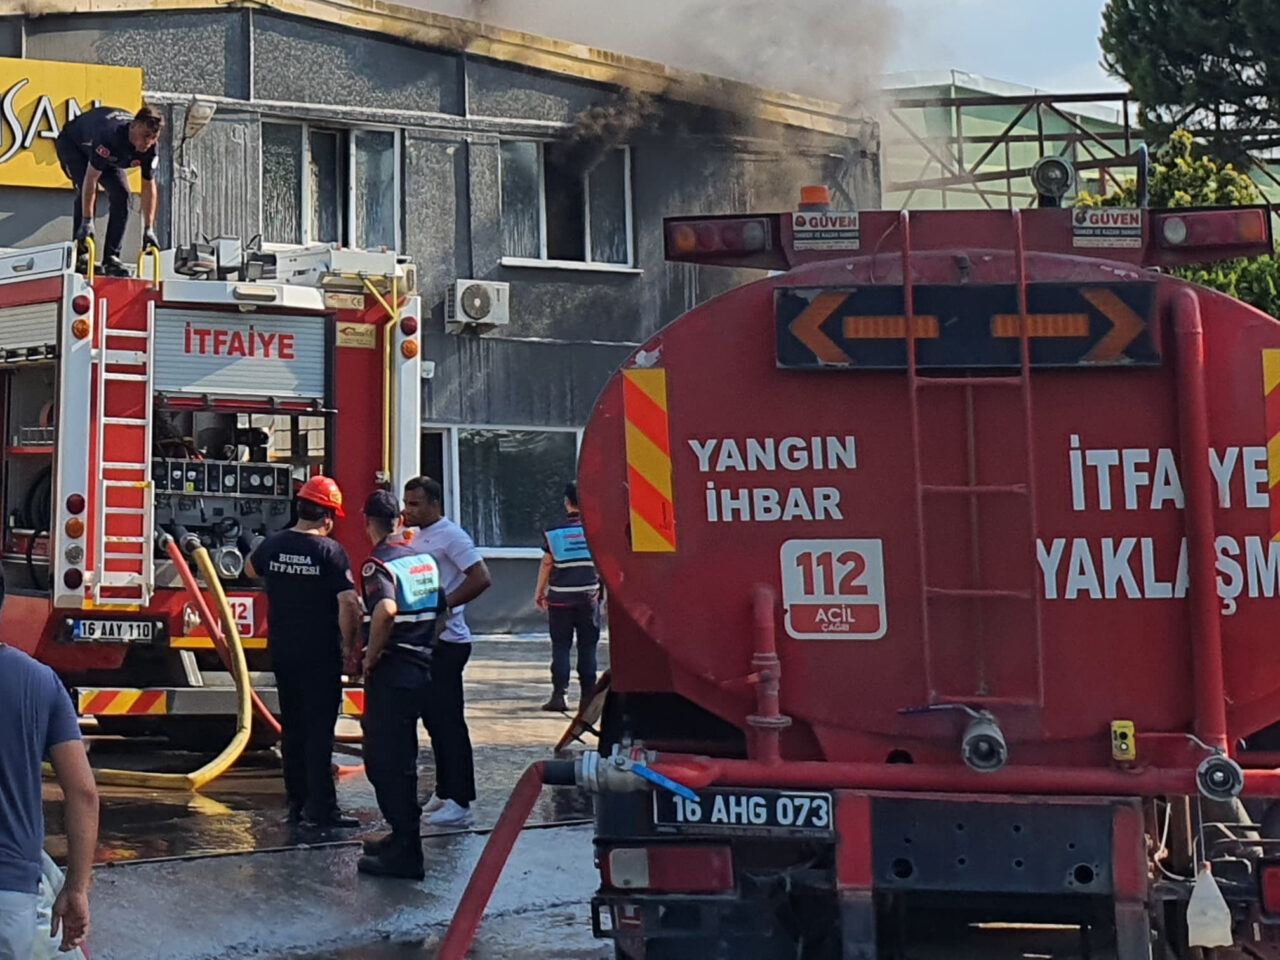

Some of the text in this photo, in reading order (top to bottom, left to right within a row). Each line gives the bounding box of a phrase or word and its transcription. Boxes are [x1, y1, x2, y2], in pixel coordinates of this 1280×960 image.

[809, 213, 857, 229] GÜVEN
[1090, 210, 1140, 226] GÜVEN
[184, 321, 296, 360] İTFAİYE
[687, 435, 857, 472] YANGIN
[1068, 434, 1271, 511] İTFAYE
[705, 480, 844, 522] İHBAR
[269, 560, 321, 576] İTFAİYESİ
[278, 552, 312, 565] BURSA
[795, 550, 869, 596] 112
[230, 602, 248, 620] 12
[814, 604, 856, 624] ACİL
[81, 621, 150, 638] 16 AAY 110
[672, 794, 829, 827] 16 AHG 073
